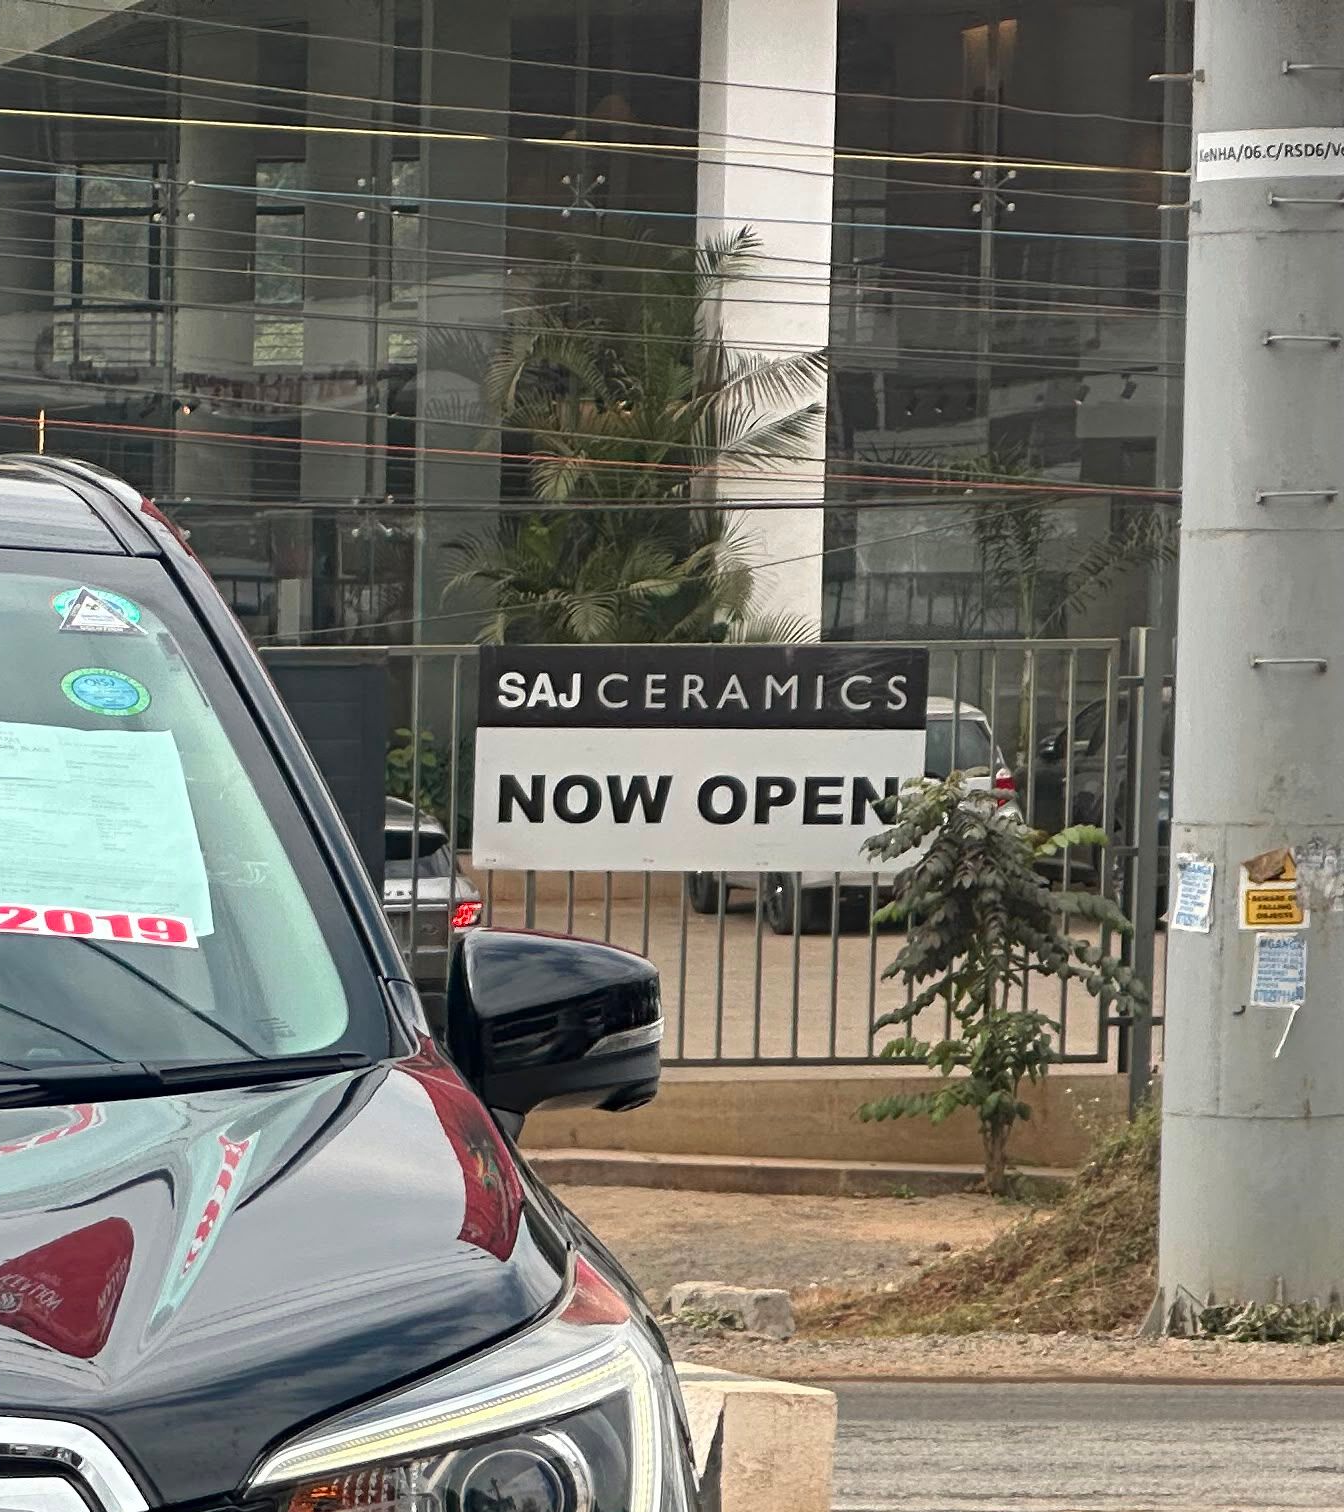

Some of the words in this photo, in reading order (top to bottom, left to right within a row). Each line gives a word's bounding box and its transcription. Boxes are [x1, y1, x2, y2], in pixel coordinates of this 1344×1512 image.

[498, 672, 582, 708] SAJ
[597, 673, 909, 711] CERAMICS
[497, 775, 673, 824] NOW
[697, 775, 901, 825] OPEN
